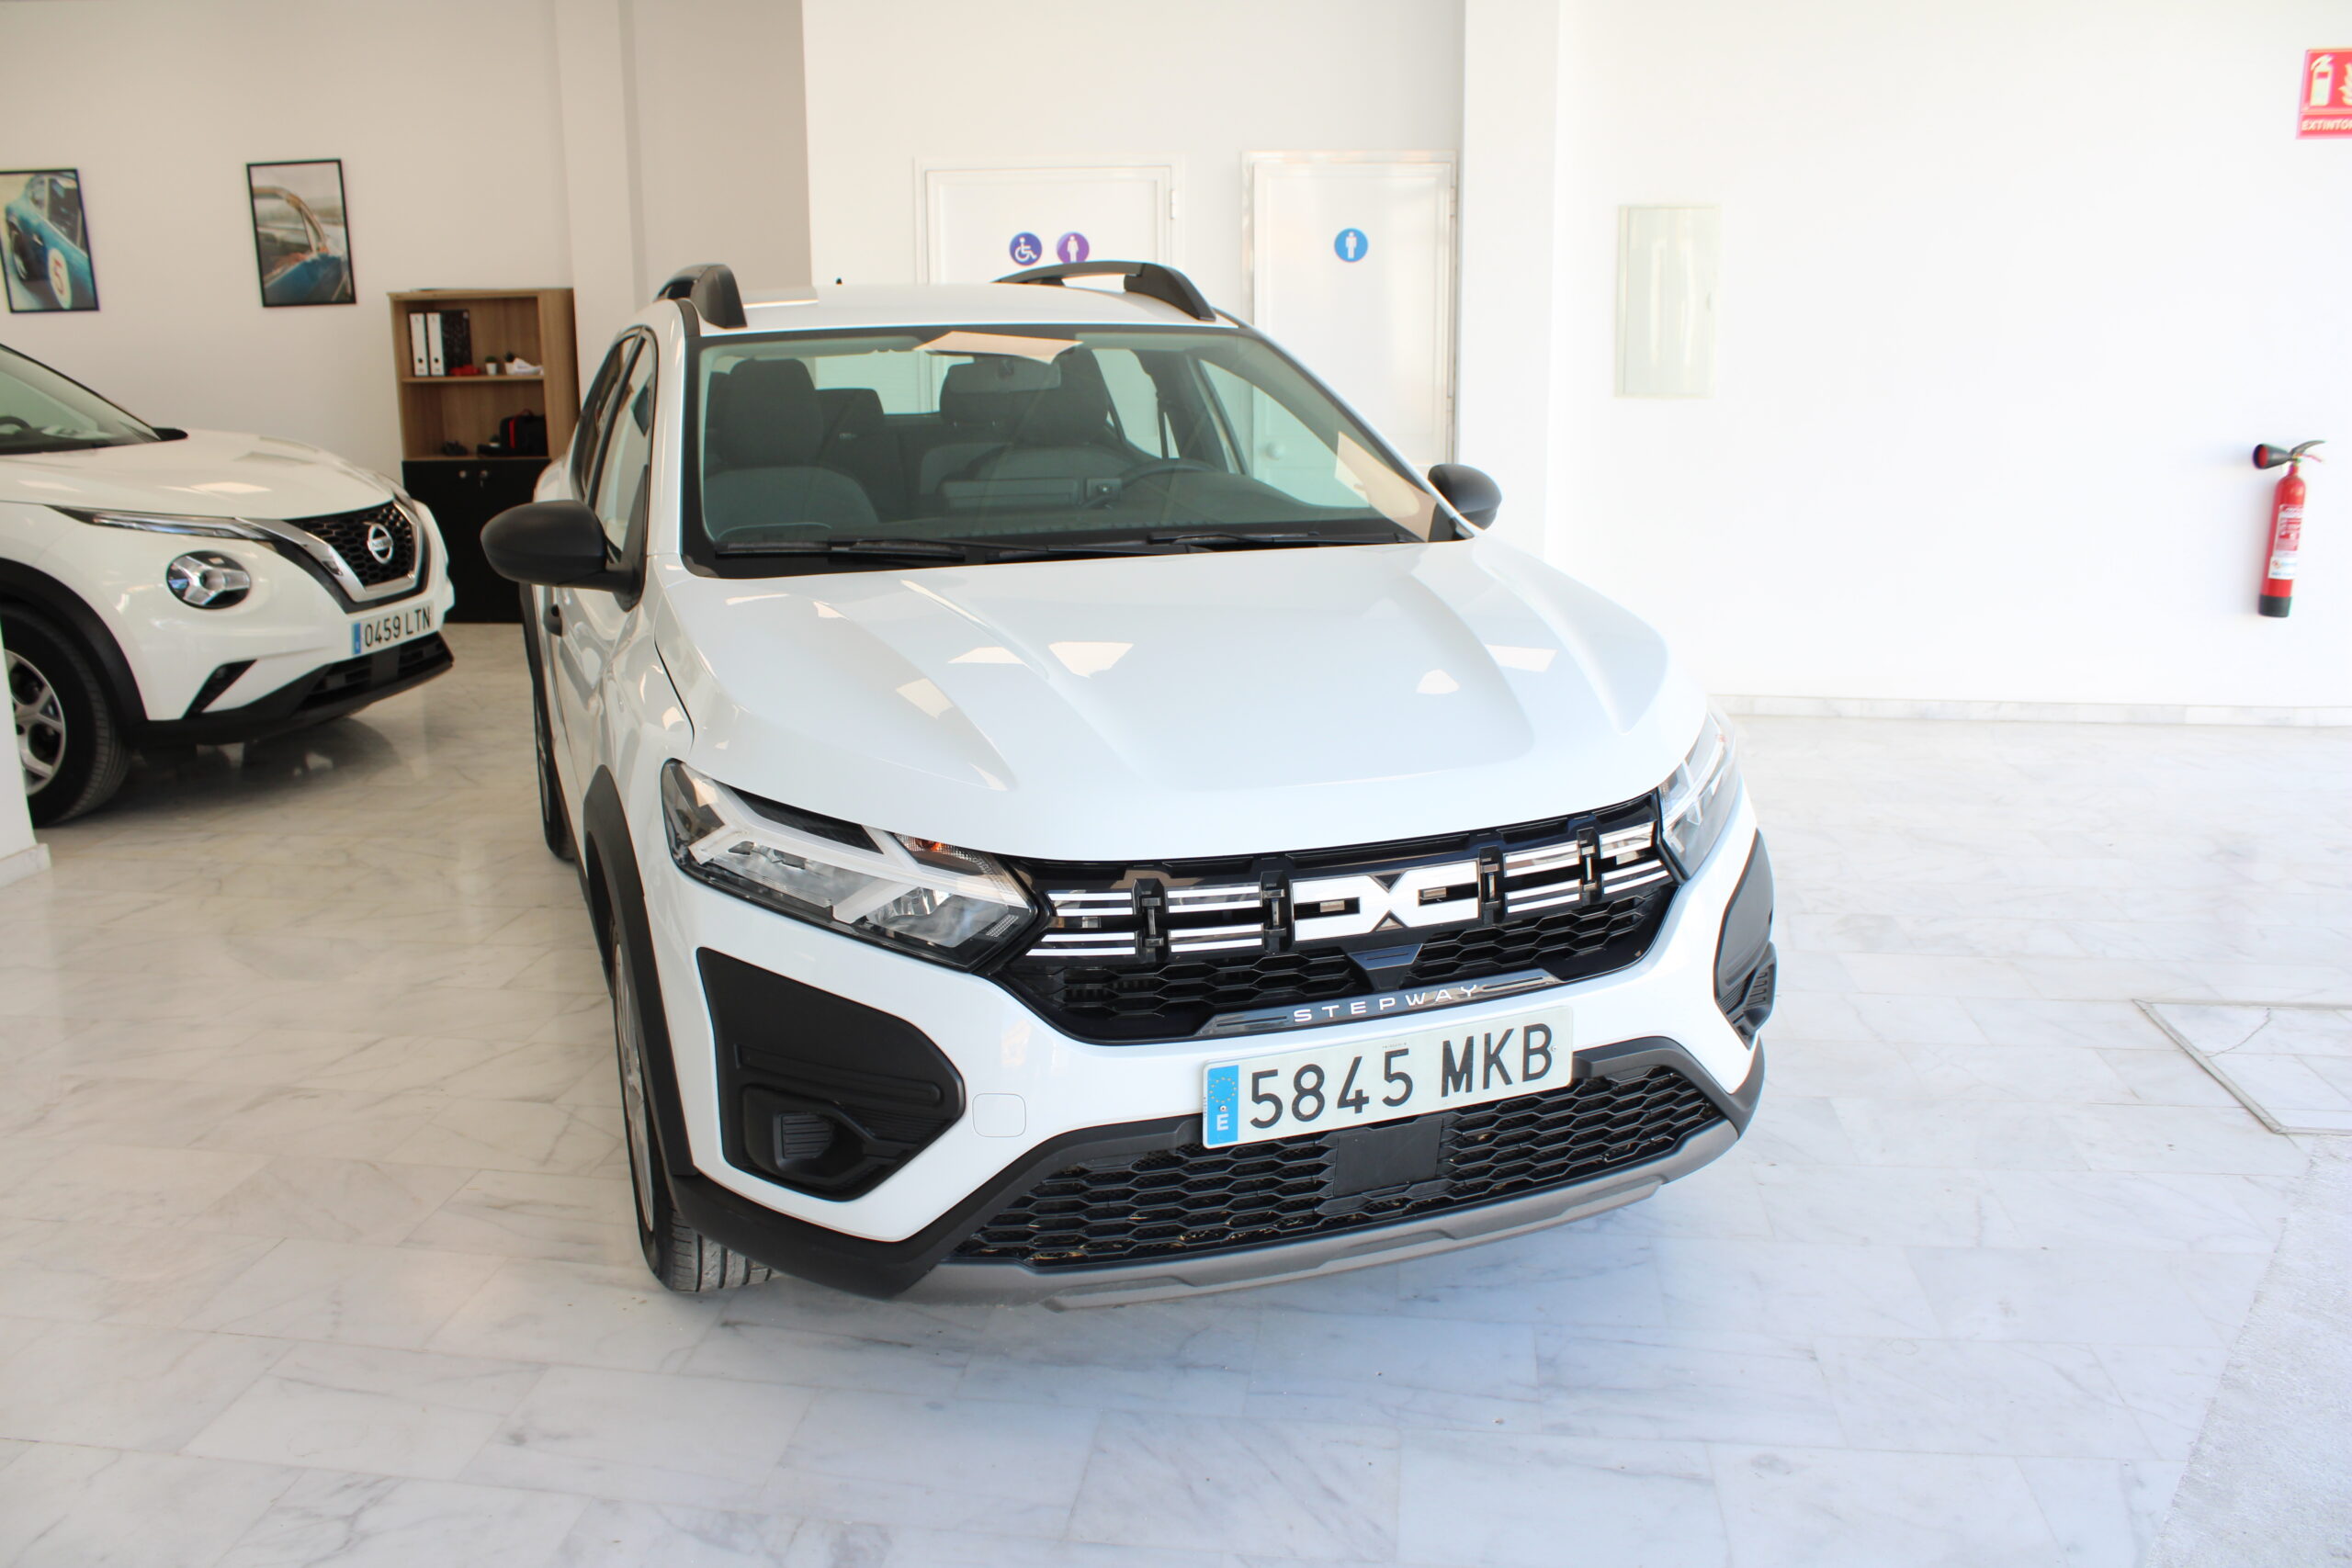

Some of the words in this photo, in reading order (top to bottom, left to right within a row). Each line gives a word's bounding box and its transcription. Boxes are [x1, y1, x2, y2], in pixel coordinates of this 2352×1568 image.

[365, 615, 401, 647] 0459
[405, 606, 431, 635] LTN
[1293, 984, 1477, 1022] STEPWAY
[1216, 1112, 1229, 1132] E
[1250, 1048, 1414, 1129] 5845
[1441, 1022, 1553, 1098] MKB
